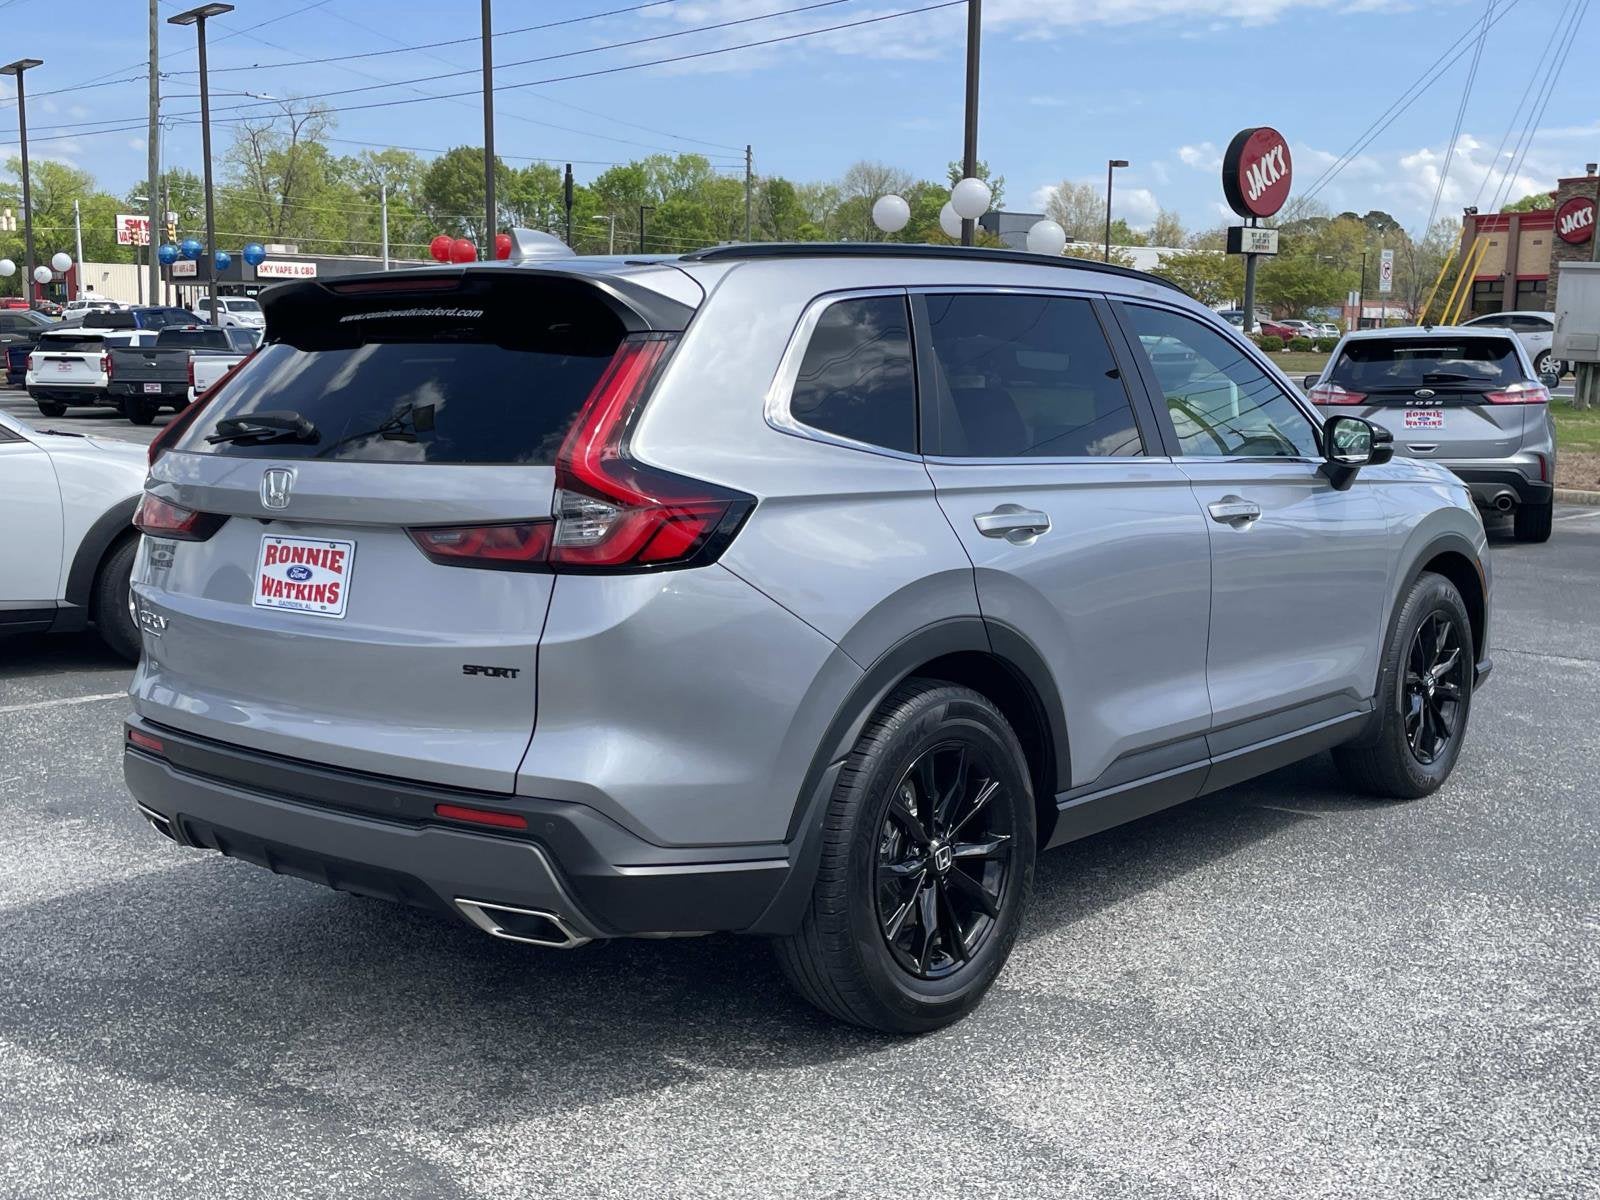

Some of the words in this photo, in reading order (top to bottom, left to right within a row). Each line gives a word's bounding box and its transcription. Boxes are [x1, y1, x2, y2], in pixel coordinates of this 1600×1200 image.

[1246, 144, 1286, 200] JACK'S
[125, 218, 152, 231] SKY
[259, 264, 273, 273] SKY
[275, 265, 292, 274] VAPE
[294, 266, 299, 275] &
[301, 266, 314, 275] CBD
[264, 544, 345, 575] RONNIE
[289, 566, 309, 580] Ford
[261, 573, 340, 604] WATKINS
[462, 664, 521, 679] SPORT
